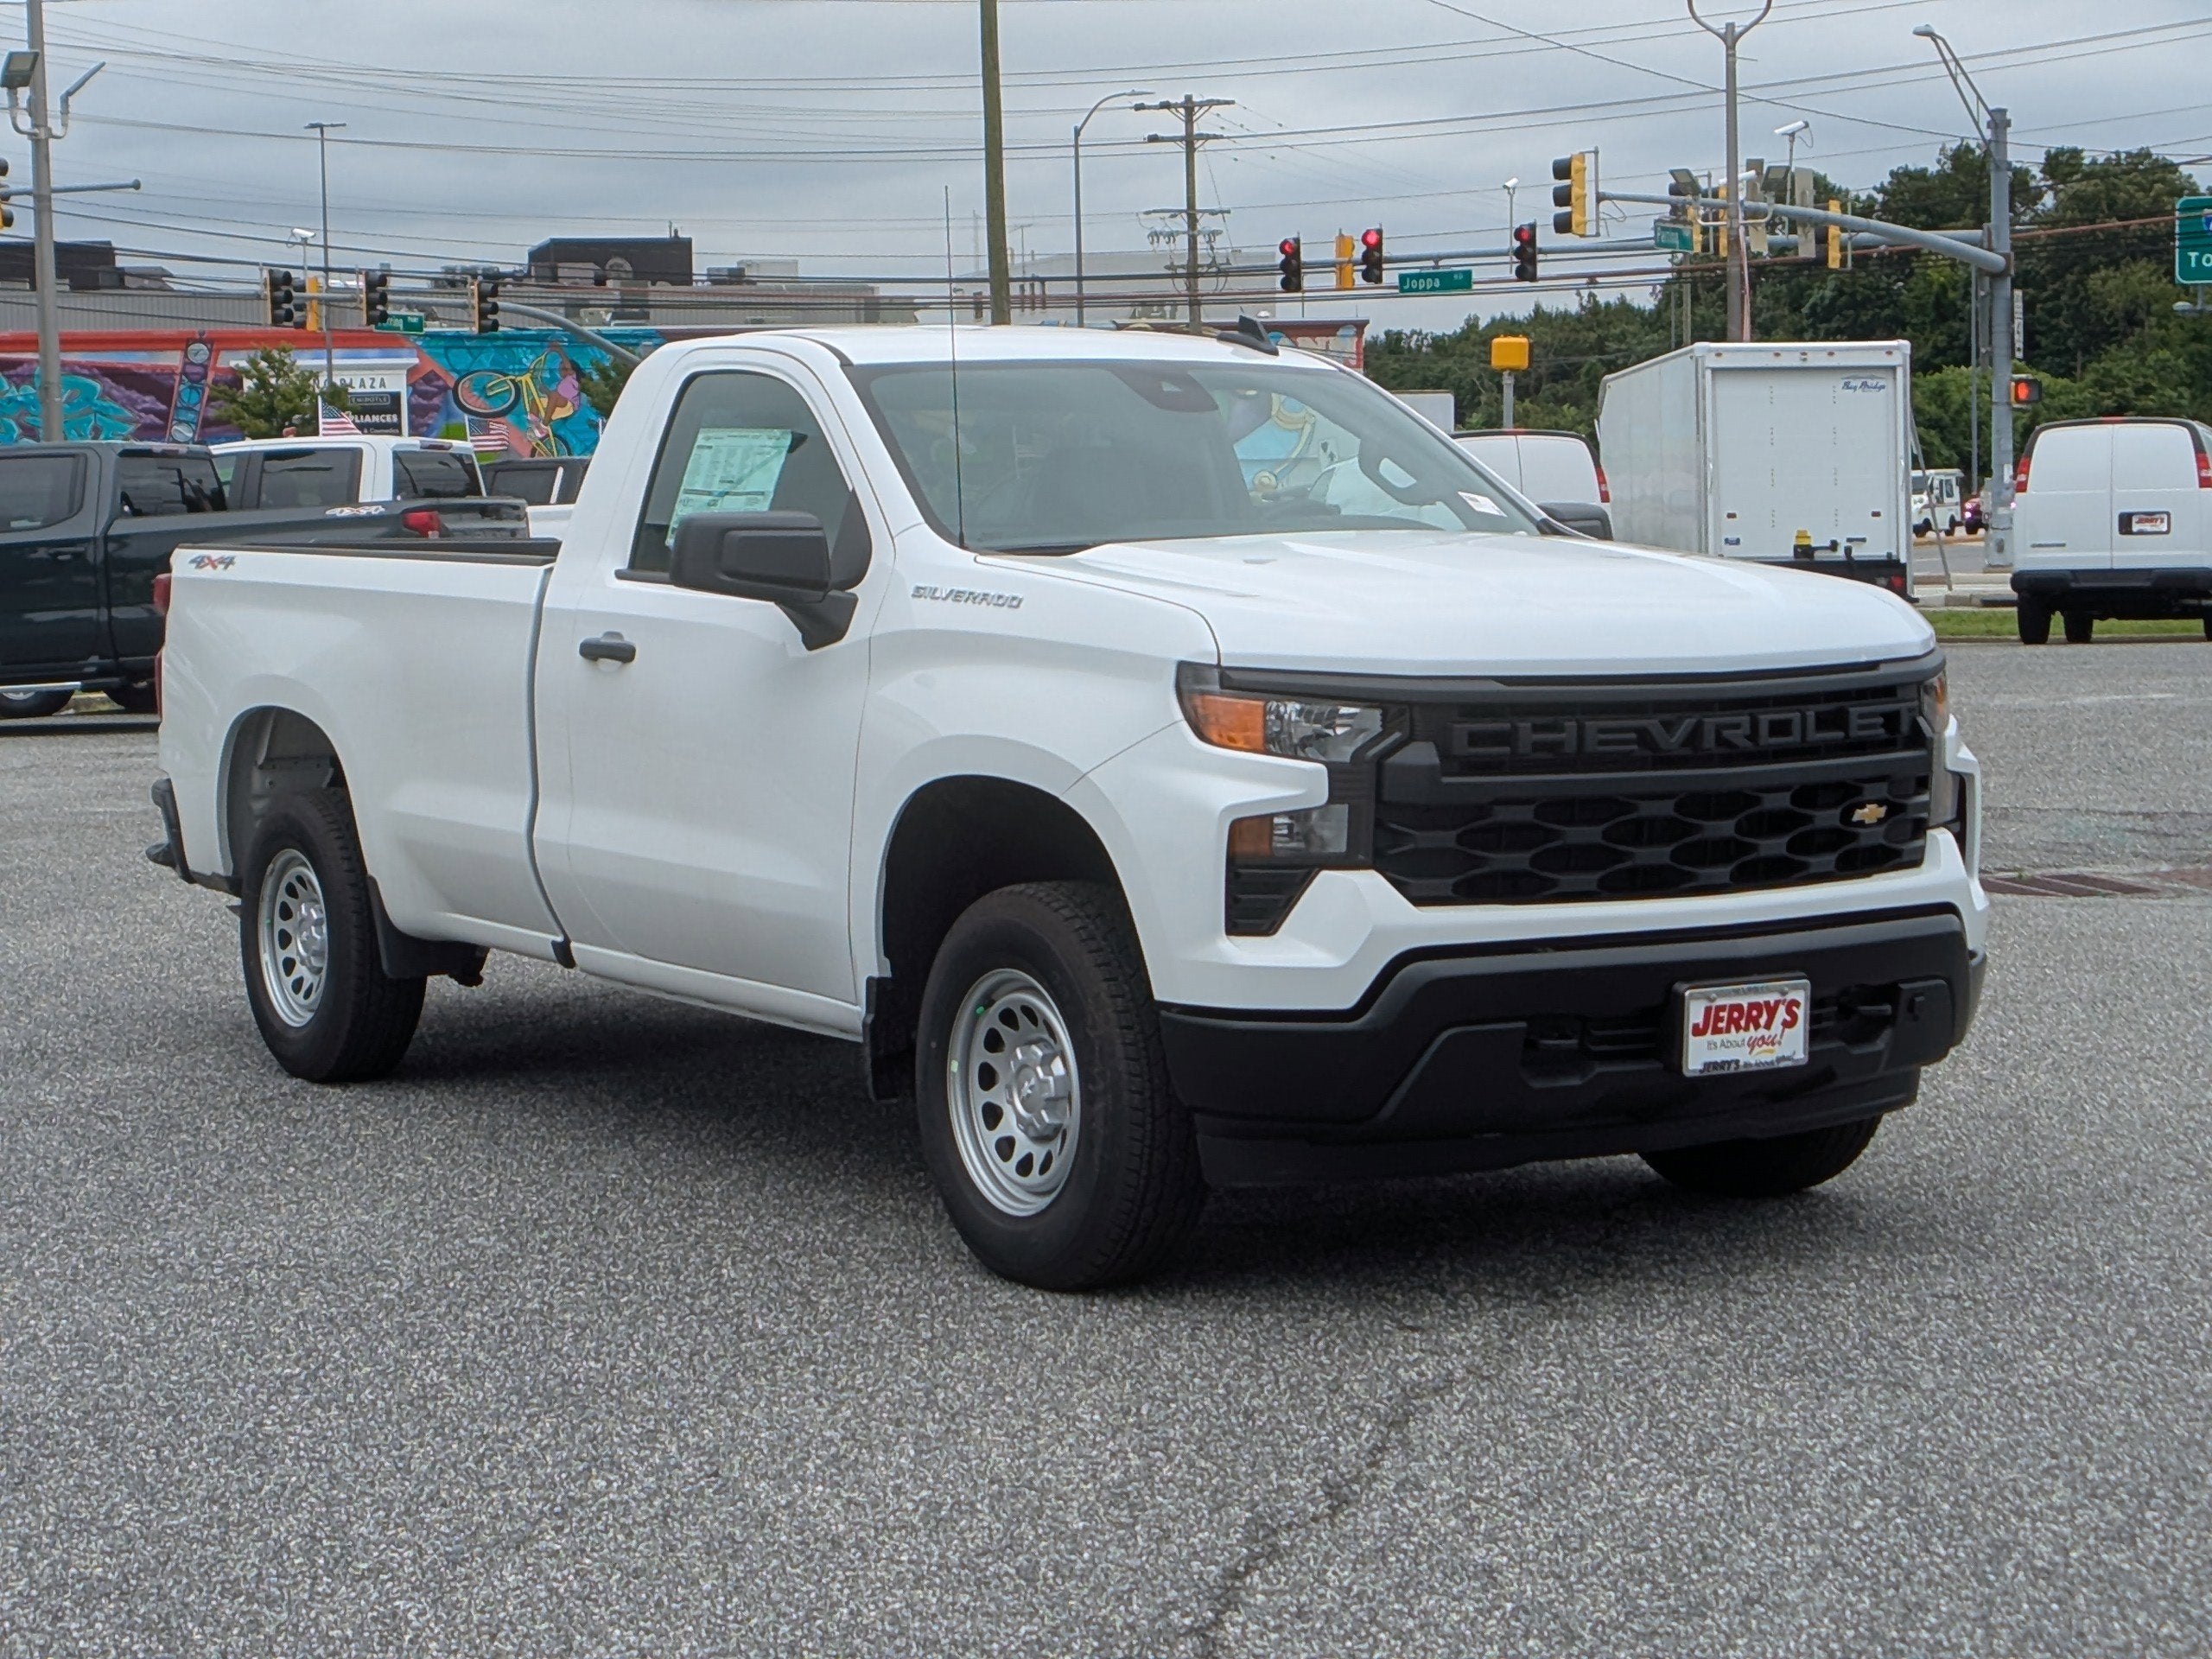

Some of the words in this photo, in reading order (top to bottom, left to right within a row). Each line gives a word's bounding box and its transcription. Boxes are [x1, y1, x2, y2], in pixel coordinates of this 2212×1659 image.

[1402, 276, 1441, 290] Joppa
[340, 377, 387, 389] PLAZA
[911, 586, 1024, 609] SILVERADO
[1450, 701, 1917, 755] CHEVROLET
[1691, 998, 1802, 1038] JERRY'S
[1719, 1038, 1745, 1050] About
